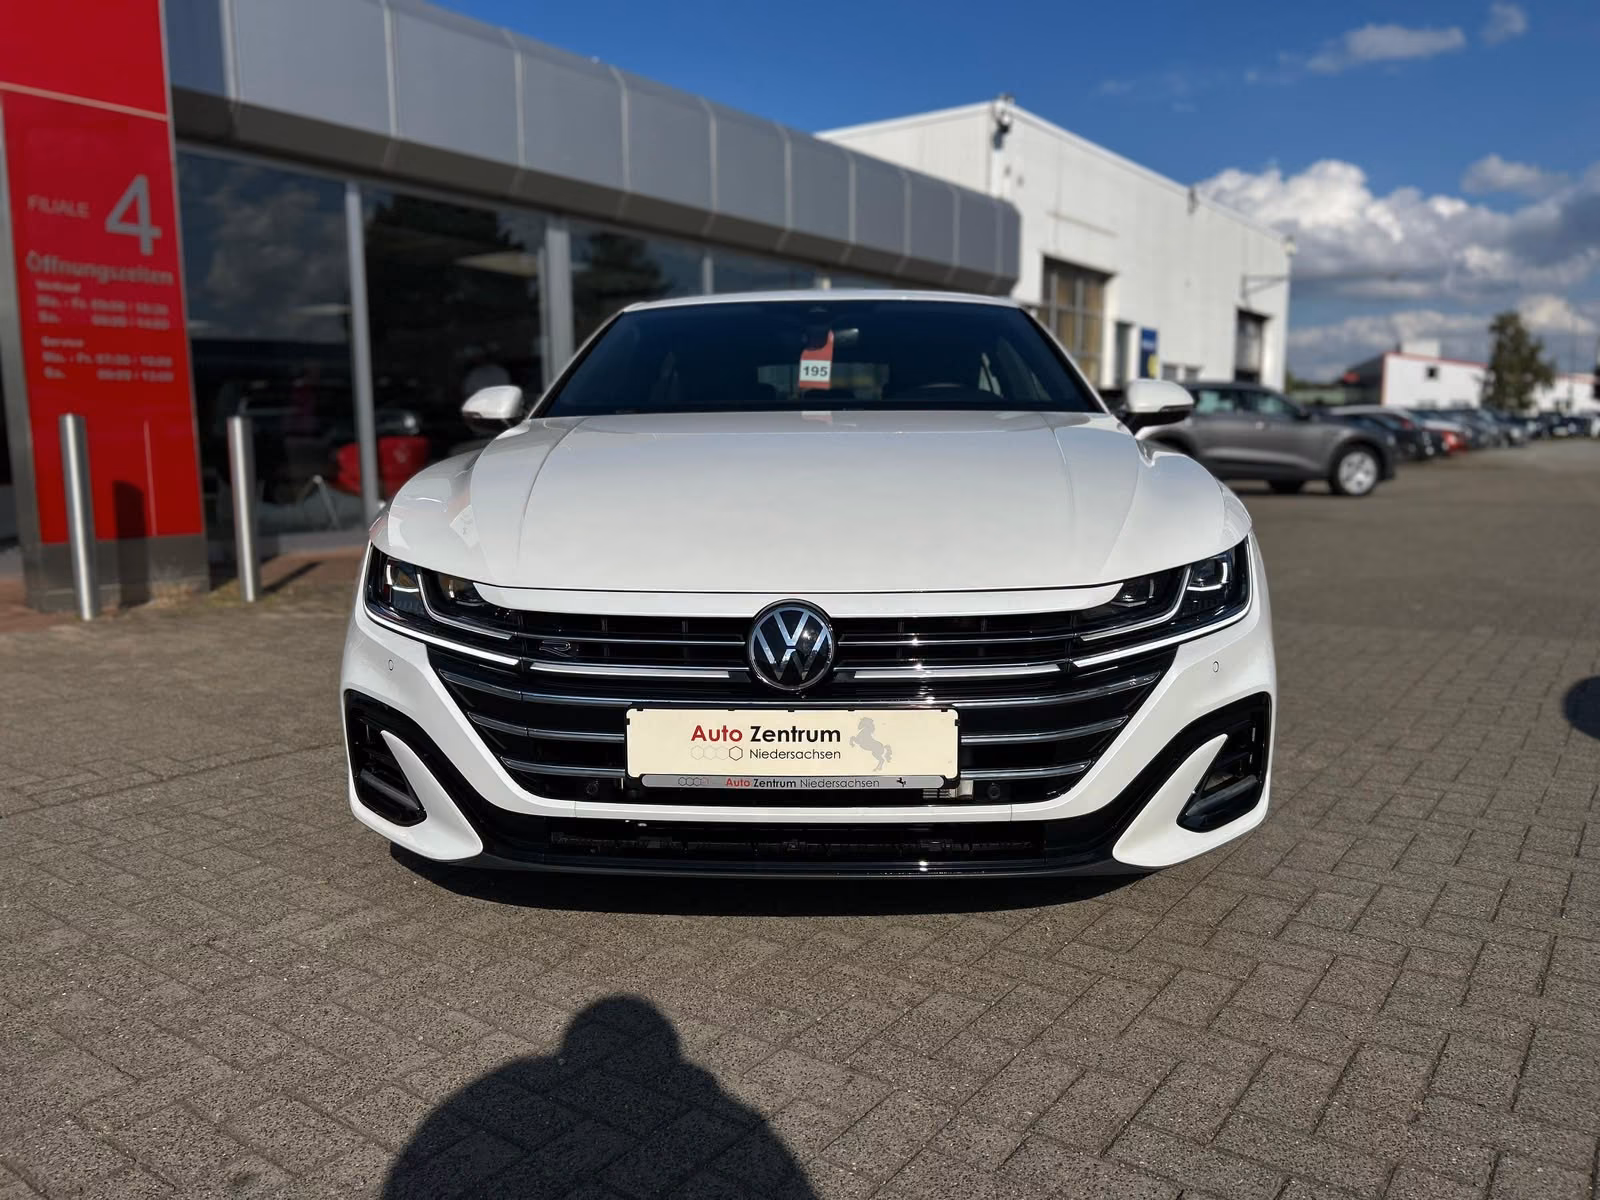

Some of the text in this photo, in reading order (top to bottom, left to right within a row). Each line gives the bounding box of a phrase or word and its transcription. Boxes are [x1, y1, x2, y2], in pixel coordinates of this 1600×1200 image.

[105, 174, 162, 256] 4
[803, 366, 828, 377] 195
[691, 724, 841, 743] Auto Zentrum
[749, 748, 841, 760] Niedersachsen
[725, 777, 880, 789] Auto Zentrum Niedersachsen
